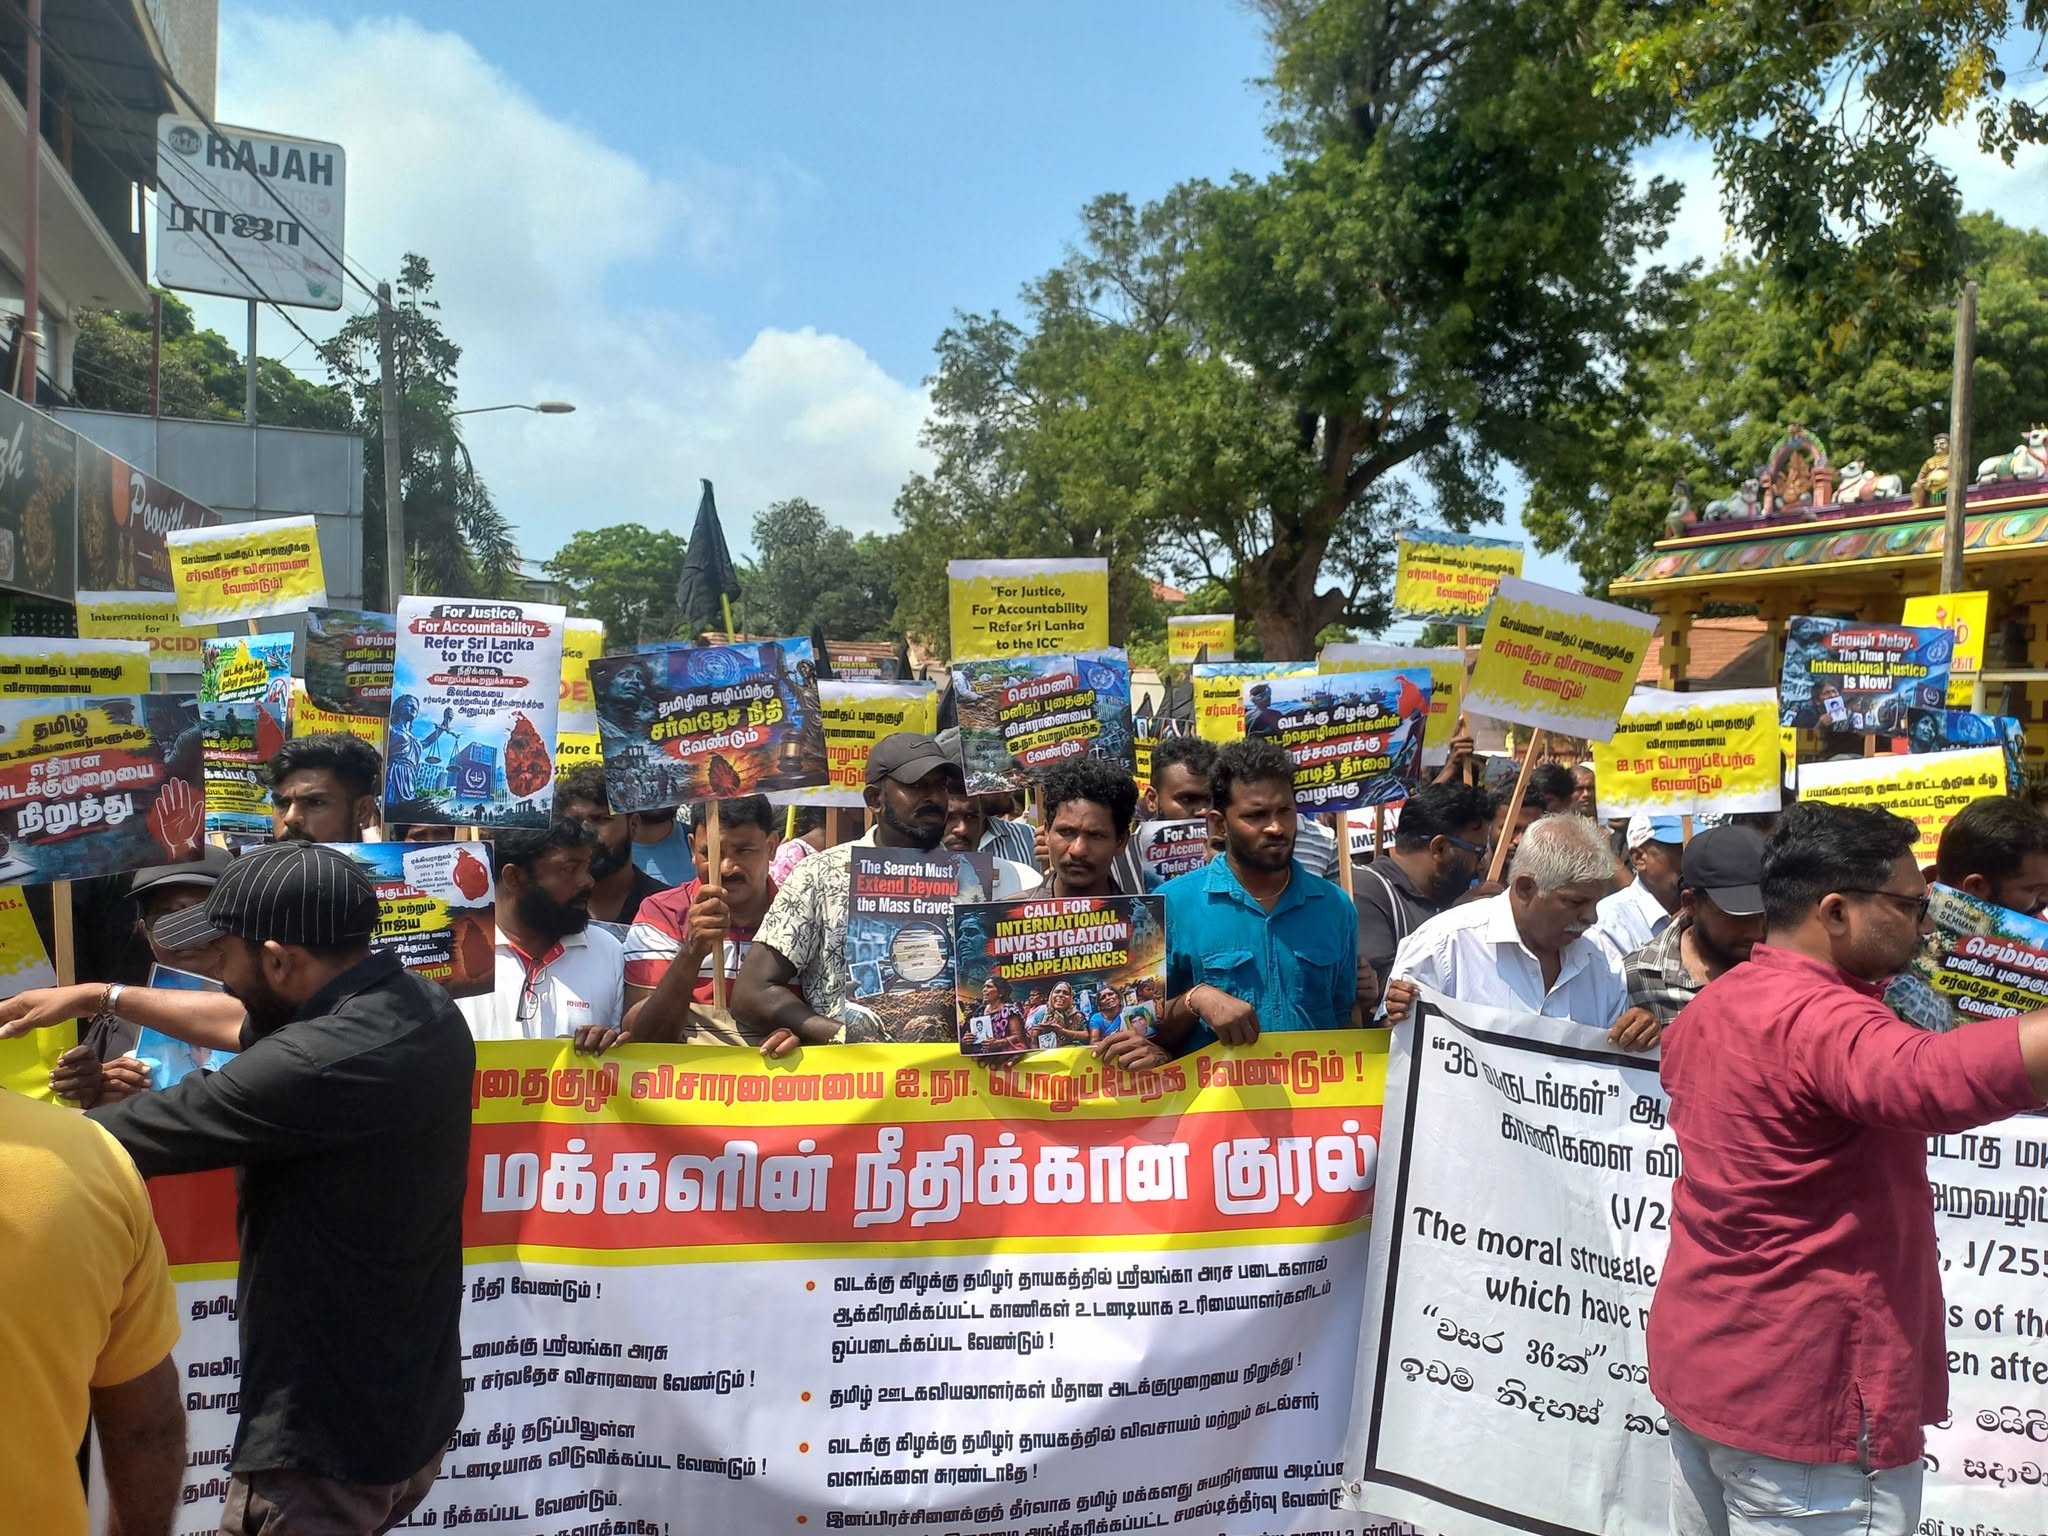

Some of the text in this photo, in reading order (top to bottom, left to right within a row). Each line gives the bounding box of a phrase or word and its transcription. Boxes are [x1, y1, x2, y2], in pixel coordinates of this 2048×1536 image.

[206, 133, 333, 186] RAJAH
[186, 561, 241, 585] சர்வதேச
[1021, 586, 1065, 598] Justice,
[442, 605, 520, 621] For Justice,
[972, 602, 1088, 616] For Accountability
[145, 624, 160, 633] for
[418, 621, 535, 637] For Accountability
[989, 620, 1085, 633] Refer Sri Lanka
[424, 637, 534, 651] Refer Sri Lanka
[997, 638, 1009, 650] to
[1013, 638, 1033, 650] the
[1495, 638, 1552, 668] சர்வதேச
[1831, 632, 1914, 649] Enough Delay.
[441, 650, 513, 664] to the ICC
[1810, 659, 1928, 678] International Justice
[1839, 649, 1902, 662] The Time for
[1007, 676, 1073, 702] செம்மணி
[1843, 675, 1892, 690] Is Now!
[650, 698, 783, 742] சர்வதேச நீதி
[1000, 699, 1041, 722] மனிதப்
[1277, 703, 1380, 731] வடக்கு கிழக்கு
[33, 712, 88, 739] தமிழ்
[679, 726, 759, 756] வேண்டும்
[30, 754, 101, 778] எதிரான
[1651, 774, 1722, 794] வேண்டும்
[17, 792, 135, 837] நிறுத்து
[1163, 828, 1184, 843] For
[1150, 847, 1167, 860] For
[860, 860, 952, 878] The Search Must
[1161, 861, 1188, 874] Refer
[857, 876, 959, 897] Extend Beyond
[857, 898, 954, 915] the Mass Graves
[1024, 900, 1091, 919] CALL FOR
[995, 909, 1119, 937] INTERNATIONAL
[994, 922, 1128, 954] INVESTIGATION
[1001, 950, 1128, 980] DISAPPEARANCES
[1013, 942, 1113, 964] FOR THE ENFORCED
[1945, 955, 1995, 977] மனிதப்
[1939, 974, 2000, 999] சர்வதேச
[630, 1064, 884, 1107] விசாரணையை
[895, 1066, 978, 1106] ஐ.நா.
[1196, 1049, 1345, 1096] வேண்டும்
[1501, 1112, 1633, 1173] காணிகளை
[481, 1118, 1378, 1229] மக்களின் நீதிக்கான குரல்
[1413, 1207, 1658, 1288] The moral struggle
[833, 1255, 1328, 1296] வடக்கு கிழக்கு தமிழர் தாயகத்தில் ஸ்ரீலங்கா அரச படைகளால்
[471, 1276, 592, 1304] நீதி வேண்டும்
[1485, 1275, 1631, 1329] which have
[832, 1279, 1332, 1328] ஆக்கிரமிக்கப்பட்ட காணிகள் உடனடியாக உரிமையாளர்களிடம்
[1974, 1304, 2005, 1332] of
[542, 1334, 623, 1358] ஸ்ரீலங்கா
[831, 1330, 1044, 1364] ஒப்படைக்கப்பட வேண்டும்
[481, 1365, 745, 1395] சர்வதேச விசாரணை வேண்டும்
[829, 1356, 1293, 1411] தமிழ் ஊடகவியலாளர்கள் மீதான அடக்குமுறையை நிறுத்து
[486, 1415, 635, 1450] கீழ் தடுப்பிலுள்ள
[827, 1391, 1319, 1459] வடக்கு கிழக்கு தமிழர் தாயகத்தில் விவசாயம் மற்றும் கடல்சார்
[548, 1445, 756, 1481] விடுவிக்கப்பட வேண்டும்
[826, 1463, 1028, 1489] வளங்களை சுரண்டாதே
[1009, 1467, 1279, 1521] தீர்வாக தமிழ் மக்களது சுயநிர்ணய
[442, 1488, 623, 1530] நீக்கப்பட வேண்டும்.
